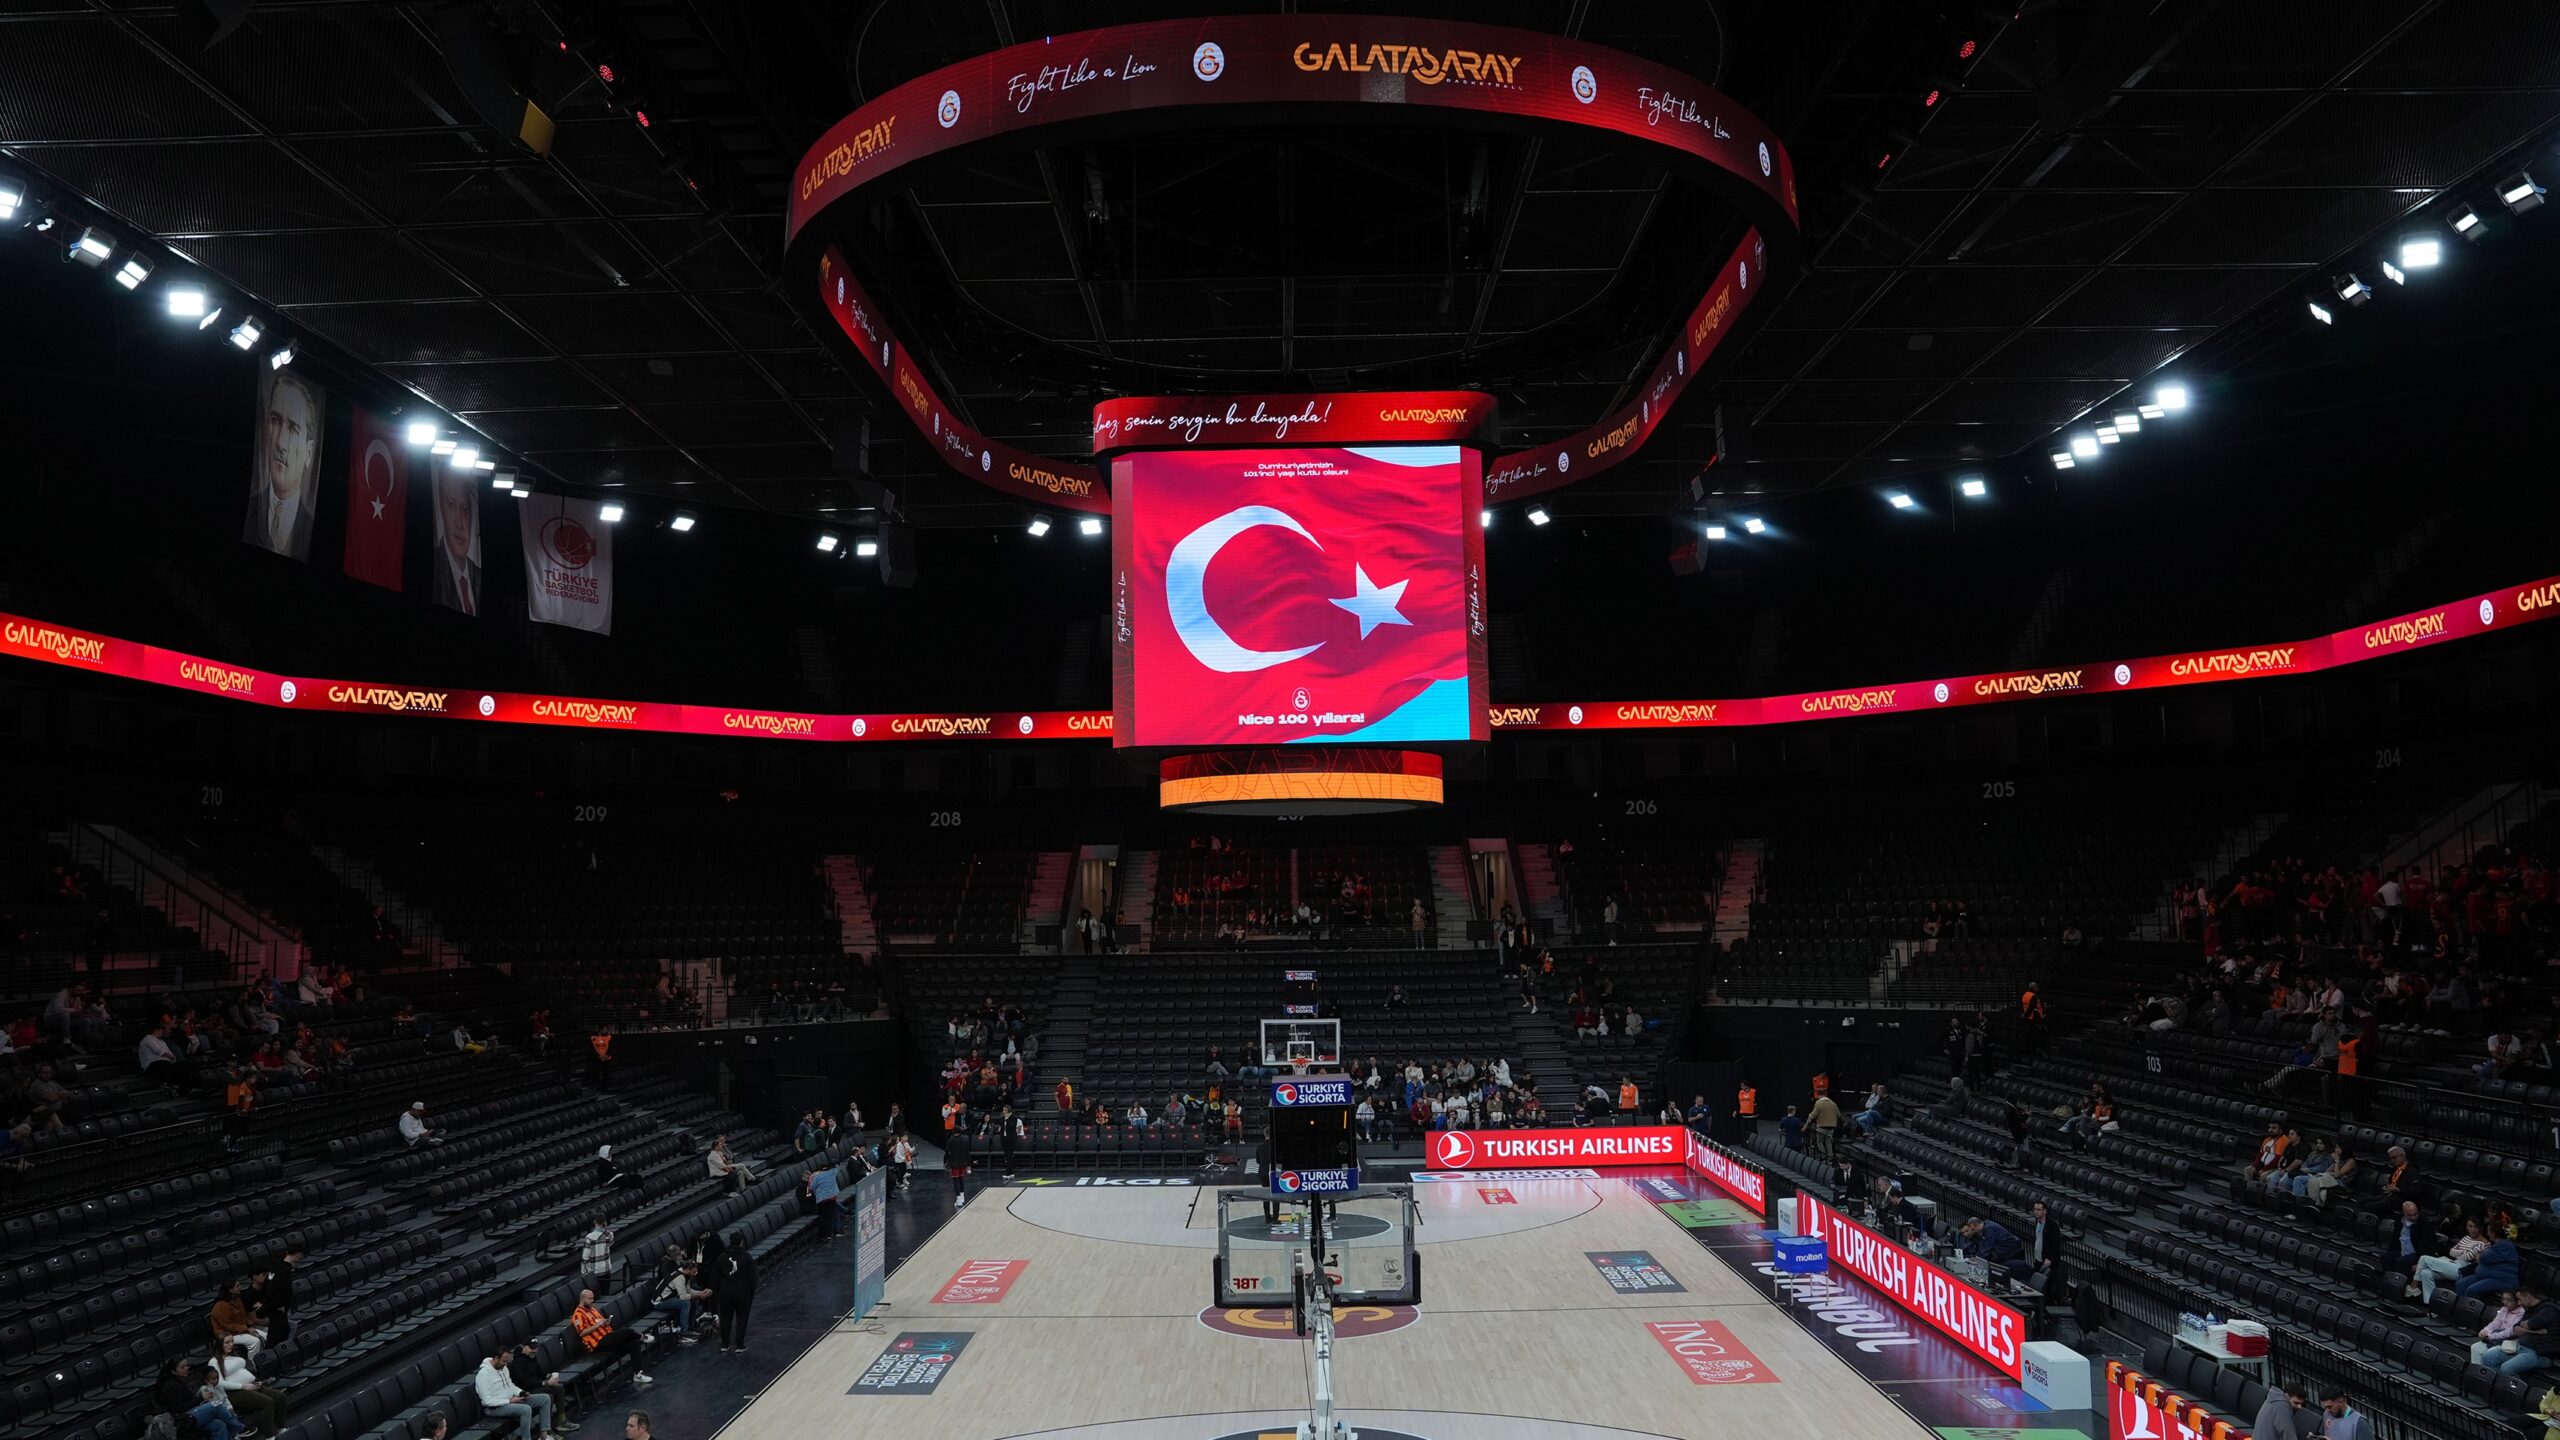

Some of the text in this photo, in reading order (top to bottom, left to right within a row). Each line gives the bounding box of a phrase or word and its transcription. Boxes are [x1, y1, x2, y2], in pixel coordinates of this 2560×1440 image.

[1293, 42, 1522, 85] GALATASARAY
[1008, 54, 1157, 113] Fight Like a Lion
[1446, 78, 1523, 91] BASKETBALL
[1637, 87, 1731, 139] Fight Like a Lion
[802, 115, 896, 201] GALATASARAY
[1094, 401, 1332, 442] lmez senin sevgin bu dünyada!
[1380, 408, 1467, 424] GALATASARAY
[1009, 462, 1092, 495] GALATASARAY
[545, 580, 599, 598] BASKETBOL
[546, 588, 599, 604] FEDERASYONU
[4, 622, 104, 659] GALATASARAY
[2365, 612, 2445, 648] GALATASARAY
[2171, 647, 2294, 675] GALATASARAY
[180, 660, 255, 692] GALATASARAY
[1974, 670, 2082, 695] GALATASARAY
[328, 686, 447, 711] GALATASARAY
[1802, 689, 1896, 712] GALATASARAY
[532, 700, 636, 723] GALATASARAY
[1238, 712, 1365, 727] Nice 100 yıllara!
[1617, 704, 1717, 723] GALATASARAY
[724, 713, 815, 734] GALATASARAY
[892, 717, 991, 736] GALATASARAY
[2376, 747, 2402, 769] 204
[201, 785, 223, 806] 210
[1982, 781, 2016, 799] 205
[573, 805, 607, 823] 209
[1625, 800, 1657, 816] 206
[930, 811, 962, 828] 208
[2147, 1056, 2161, 1072] 103
[1484, 1136, 1673, 1157] TURKISH AIRLINES
[1075, 1177, 1191, 1185] ikas
[1697, 1144, 1762, 1202] TURKISH AIRLINES
[1795, 1253, 1822, 1262] molten
[958, 1261, 1011, 1283] ING
[1833, 1216, 2015, 1368] TURKISH AIRLINES
[1654, 1321, 1728, 1356] ING
